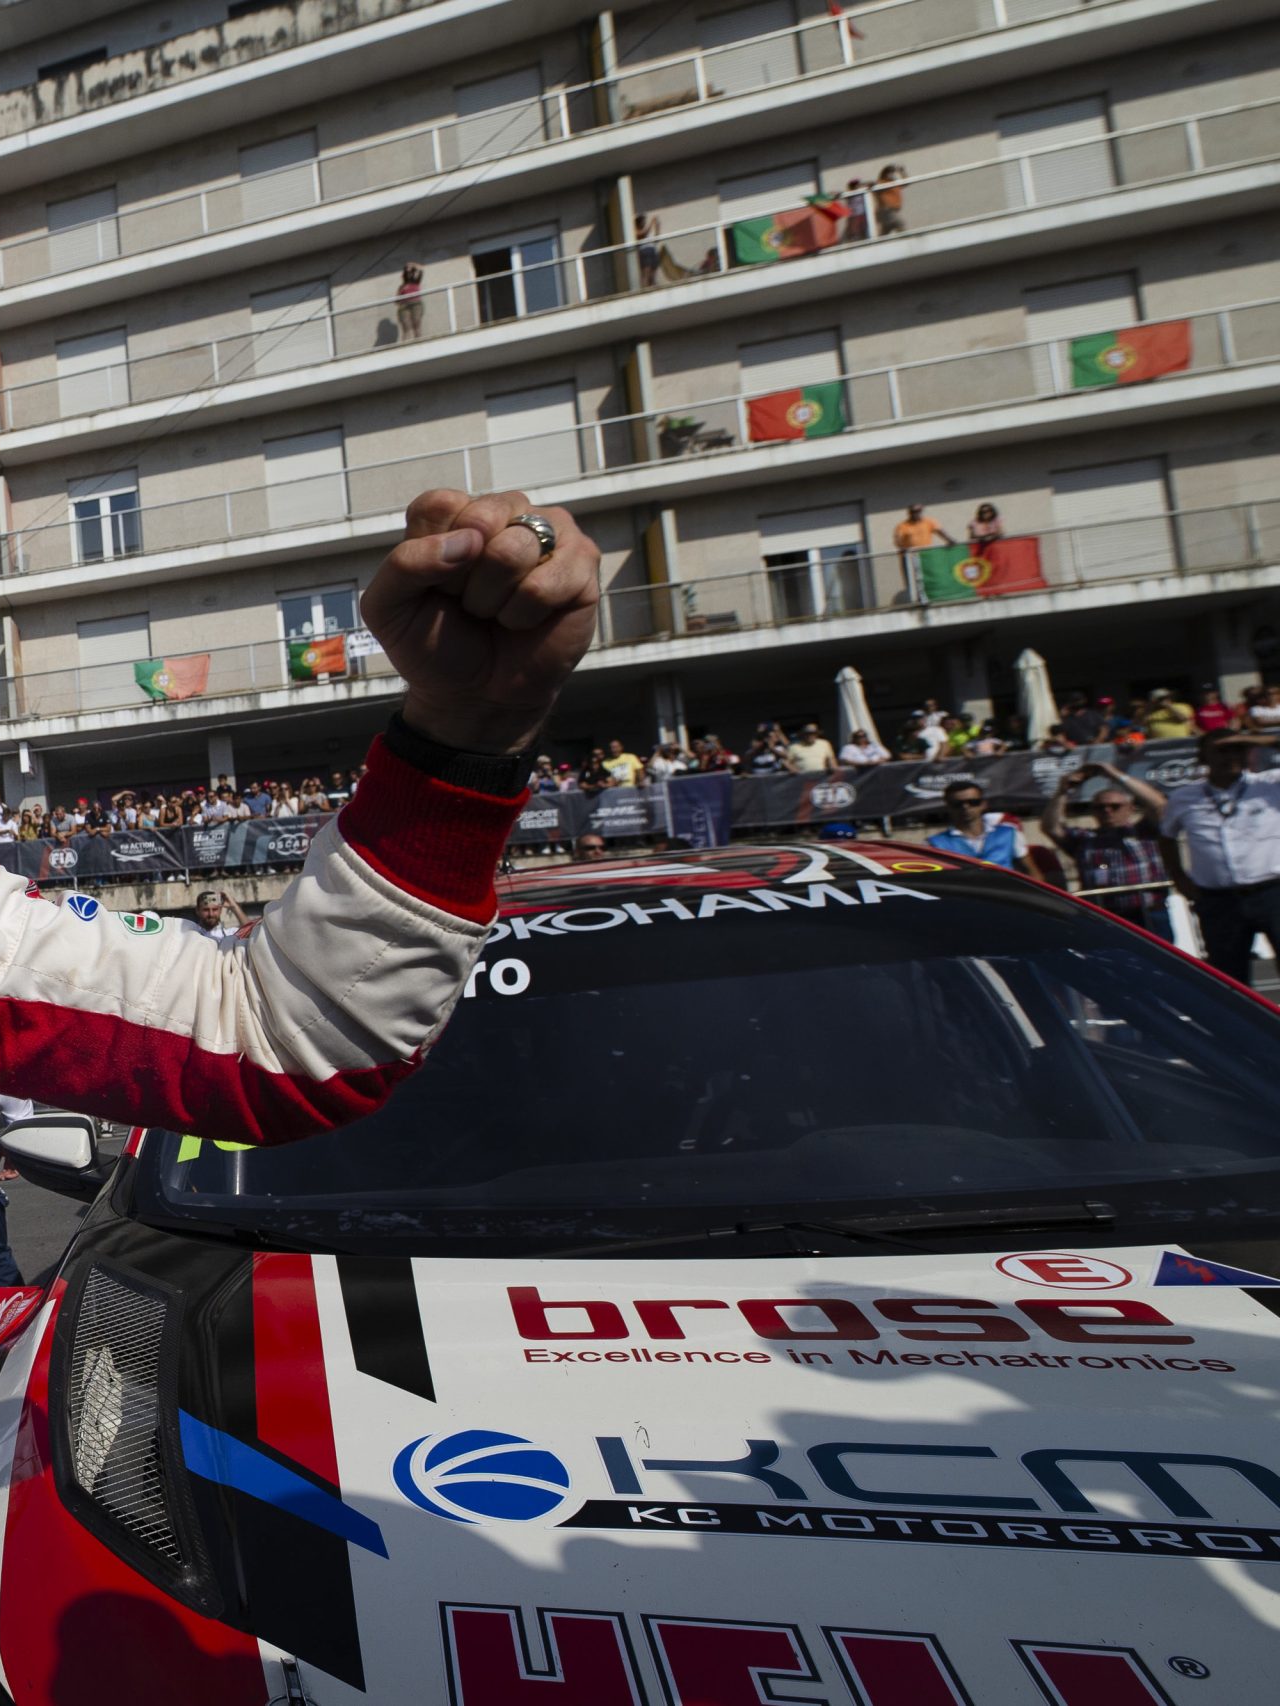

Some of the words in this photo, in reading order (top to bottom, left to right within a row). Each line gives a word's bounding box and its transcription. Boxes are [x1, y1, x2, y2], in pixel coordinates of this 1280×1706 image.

[268, 839, 312, 850] OSCAR
[51, 853, 75, 864] FIA
[1022, 1258, 1111, 1284] E
[507, 1286, 1195, 1346] brose
[523, 1348, 772, 1366] Excellence
[787, 1348, 833, 1368] in
[847, 1348, 1237, 1374] Mechatronics
[628, 1506, 721, 1526] KC
[758, 1510, 1280, 1553] MOTORGRO
